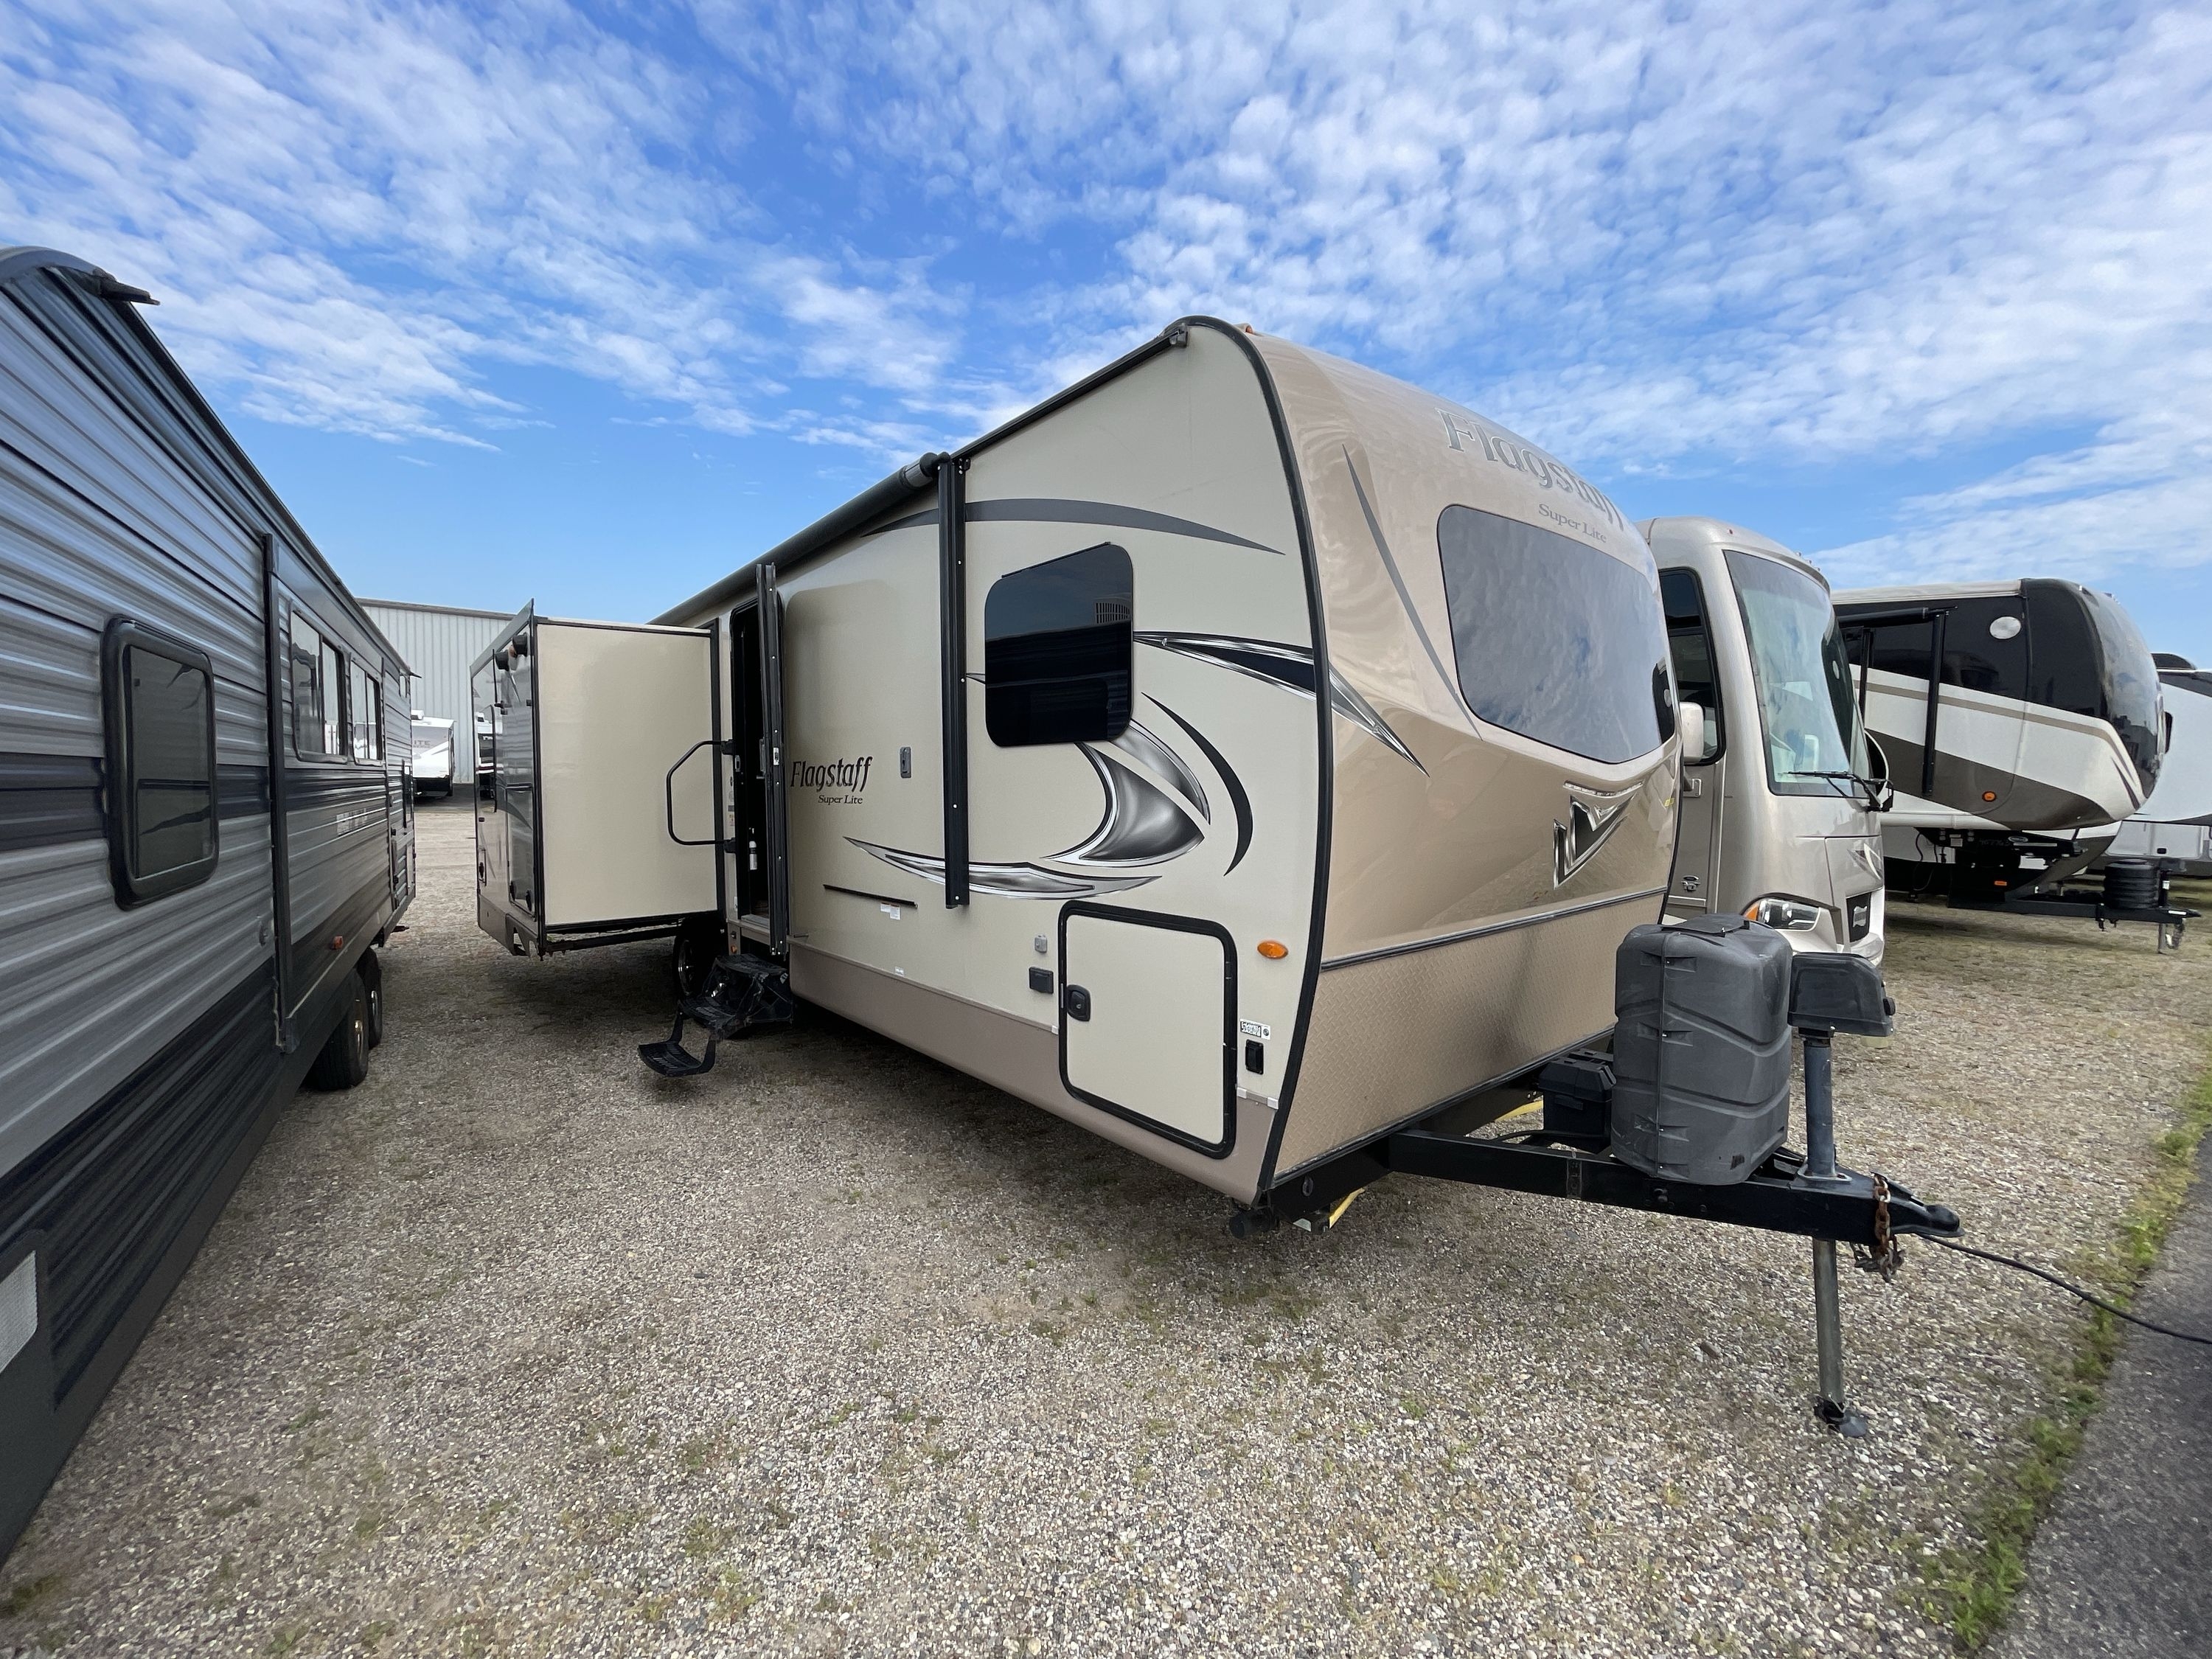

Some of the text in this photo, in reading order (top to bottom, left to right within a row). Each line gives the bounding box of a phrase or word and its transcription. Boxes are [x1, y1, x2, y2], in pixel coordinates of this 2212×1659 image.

[1435, 408, 1624, 532] Flagstaff
[1538, 503, 1607, 543] Super Lite
[790, 756, 874, 793] Flagstaff
[818, 795, 863, 805] Super Lite
